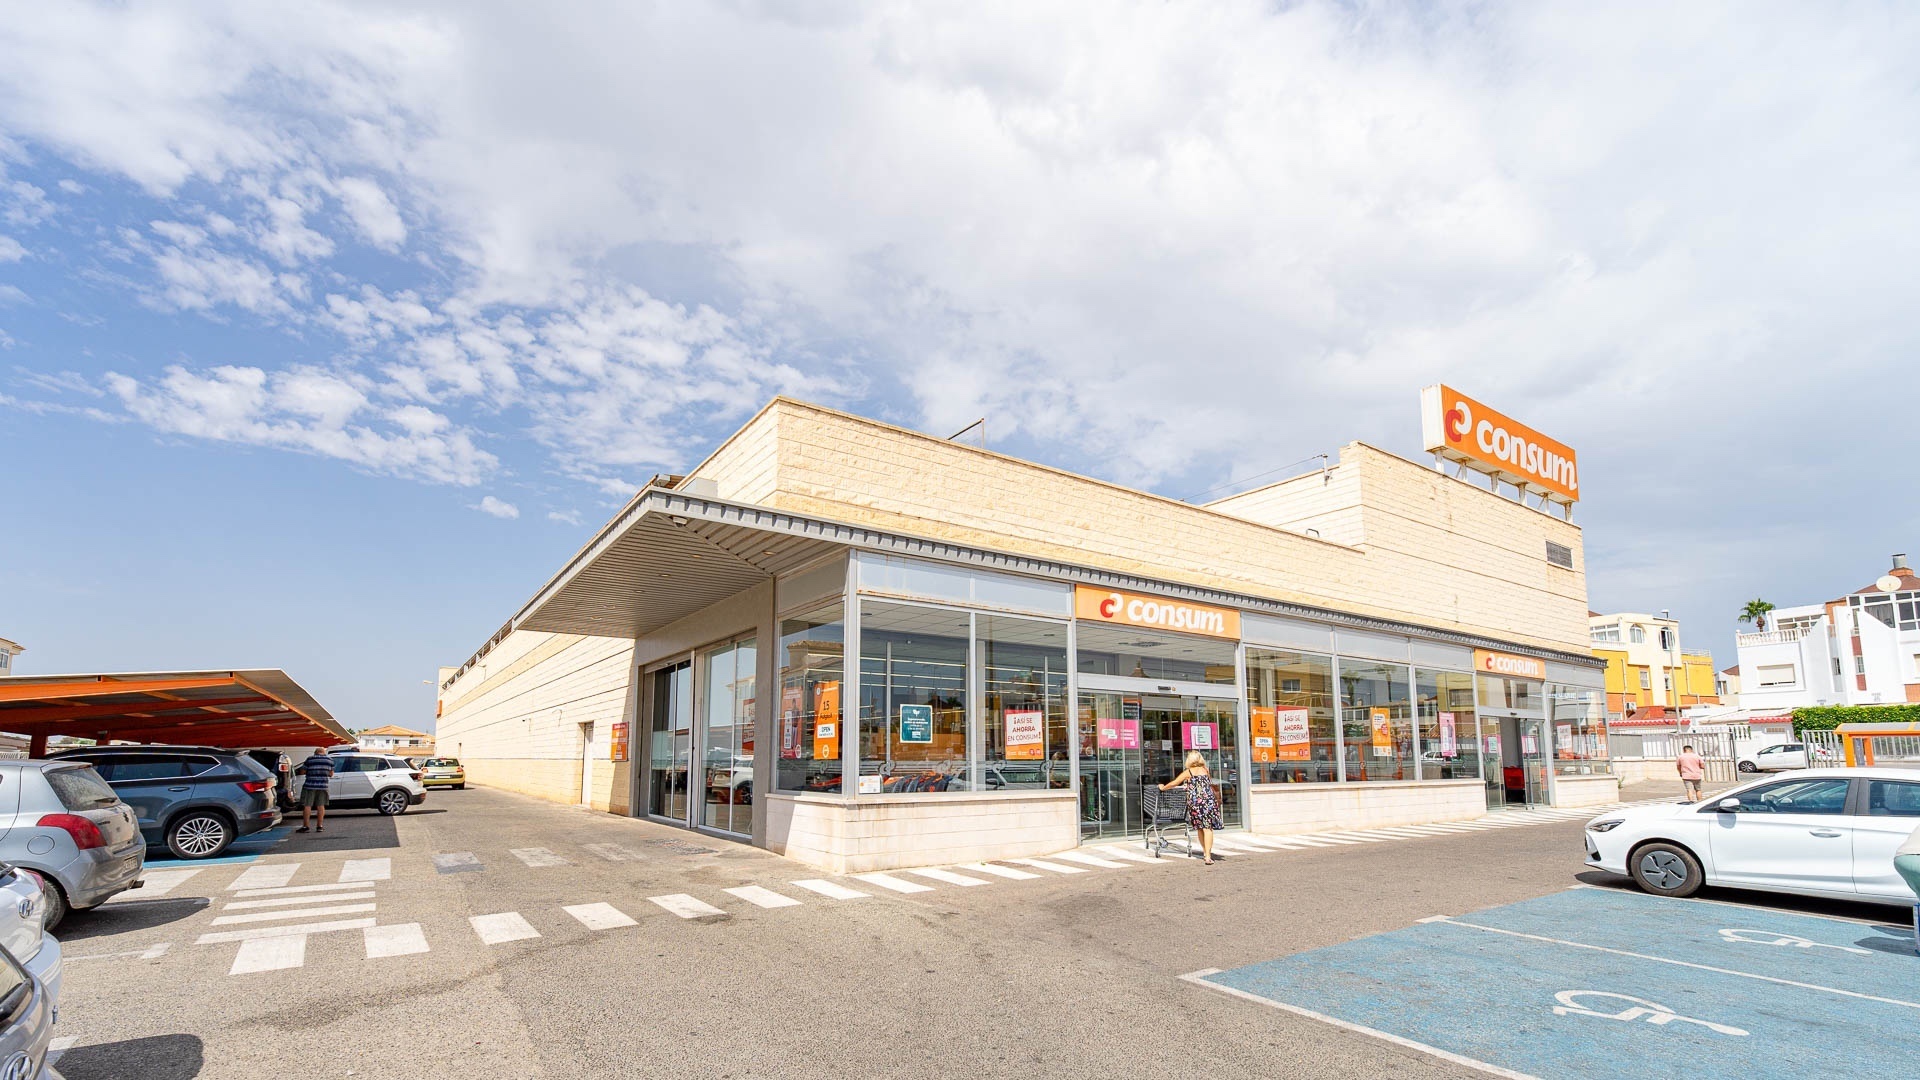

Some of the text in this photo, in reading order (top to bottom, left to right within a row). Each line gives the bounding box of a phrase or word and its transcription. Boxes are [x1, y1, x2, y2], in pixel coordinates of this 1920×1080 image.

[1477, 420, 1577, 490] consum
[1127, 600, 1224, 633] consum
[1497, 656, 1539, 676] consum
[823, 701, 830, 711] 15
[1012, 725, 1036, 733] AHORRA
[1260, 719, 1267, 728] 15
